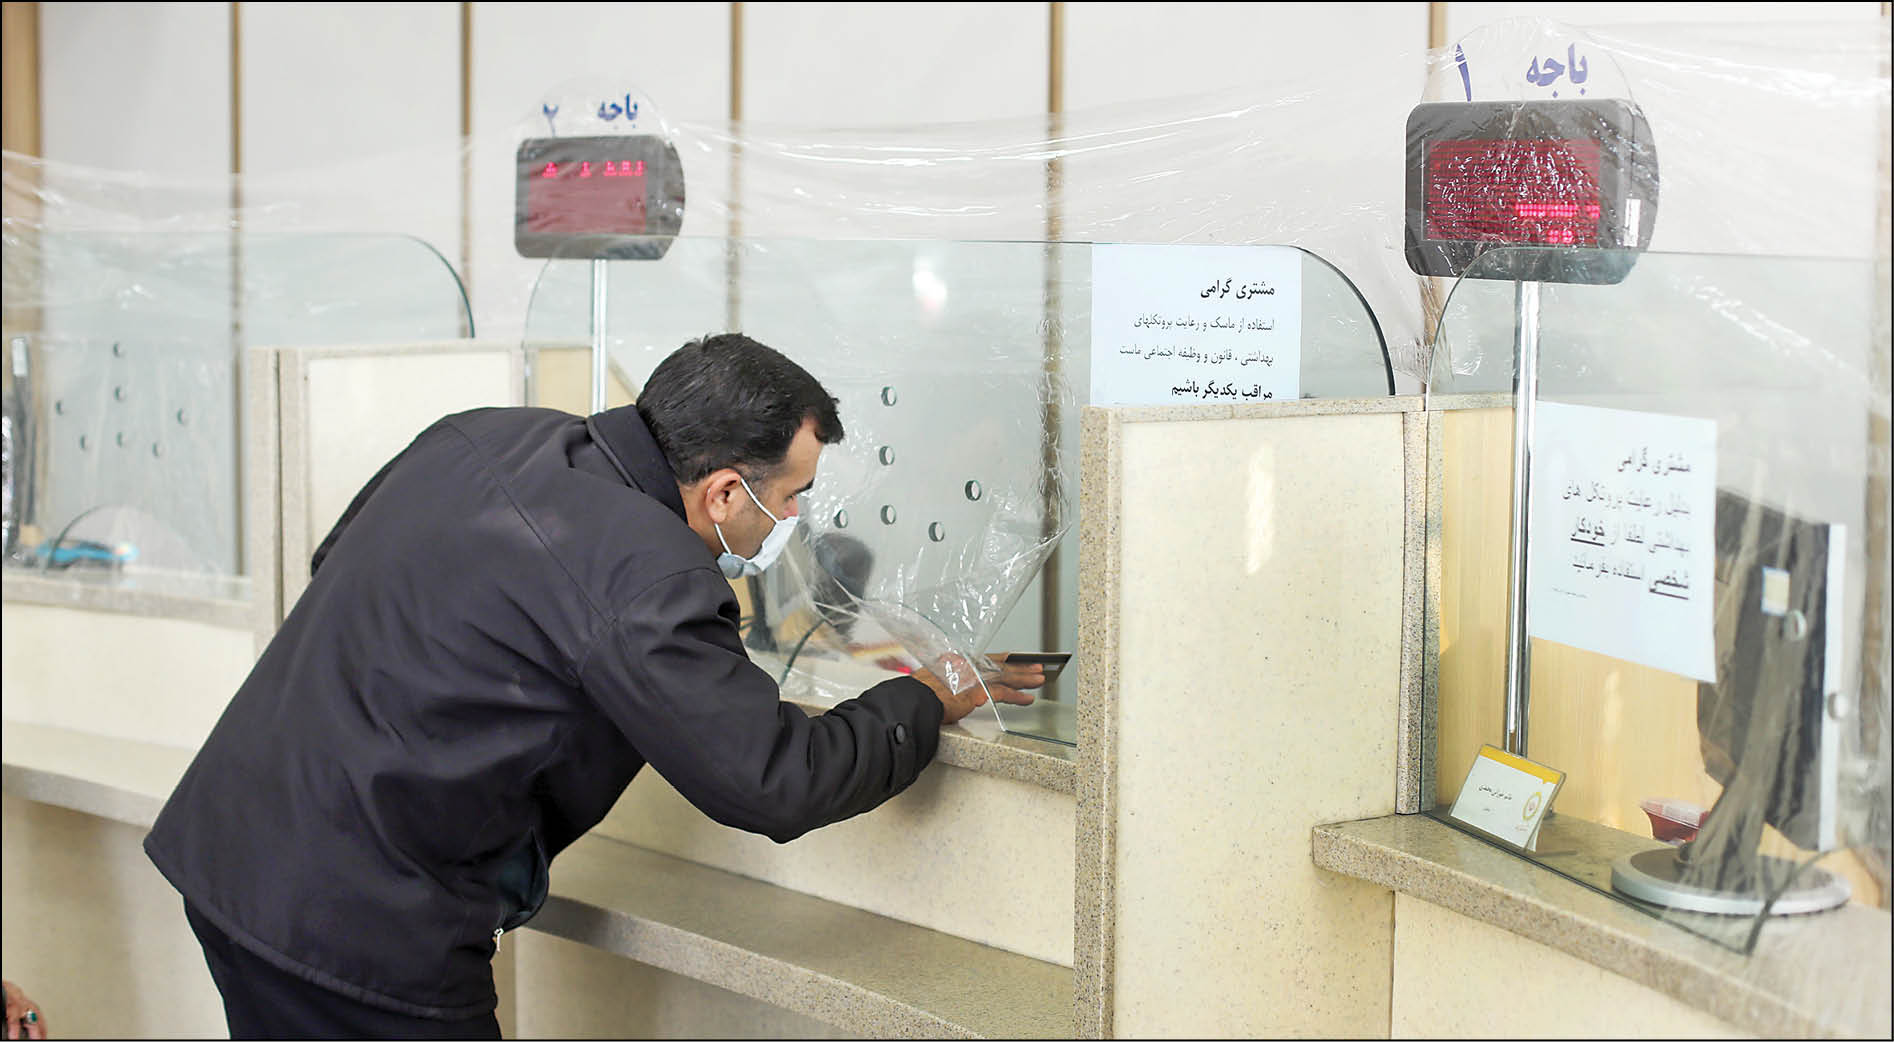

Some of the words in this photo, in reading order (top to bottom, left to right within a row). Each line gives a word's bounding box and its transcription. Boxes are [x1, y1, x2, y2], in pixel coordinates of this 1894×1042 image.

[1525, 43, 1588, 98] باجه
[598, 93, 638, 129] باجه
[543, 103, 559, 137] ۲
[1200, 278, 1232, 299] گرامی
[1236, 281, 1275, 300] مشتری
[1175, 315, 1200, 331] رعایت
[1202, 321, 1208, 332] و
[1210, 316, 1236, 329] ماسک
[1237, 316, 1245, 333] از
[1247, 318, 1275, 331] استفاده
[1119, 344, 1142, 355] ماست
[1143, 345, 1176, 361] اجتماعی
[1177, 346, 1201, 364] وظیفه
[1211, 351, 1233, 365] قانون
[1203, 353, 1209, 364] و
[1240, 350, 1274, 367] بهداشتی
[1171, 378, 1200, 397] باشیم
[1202, 379, 1238, 400] یکدیگر
[1241, 384, 1273, 401] مراقب
[1617, 446, 1648, 473] گرامی
[1653, 453, 1690, 477] مشتری
[1569, 515, 1605, 541] خودکار
